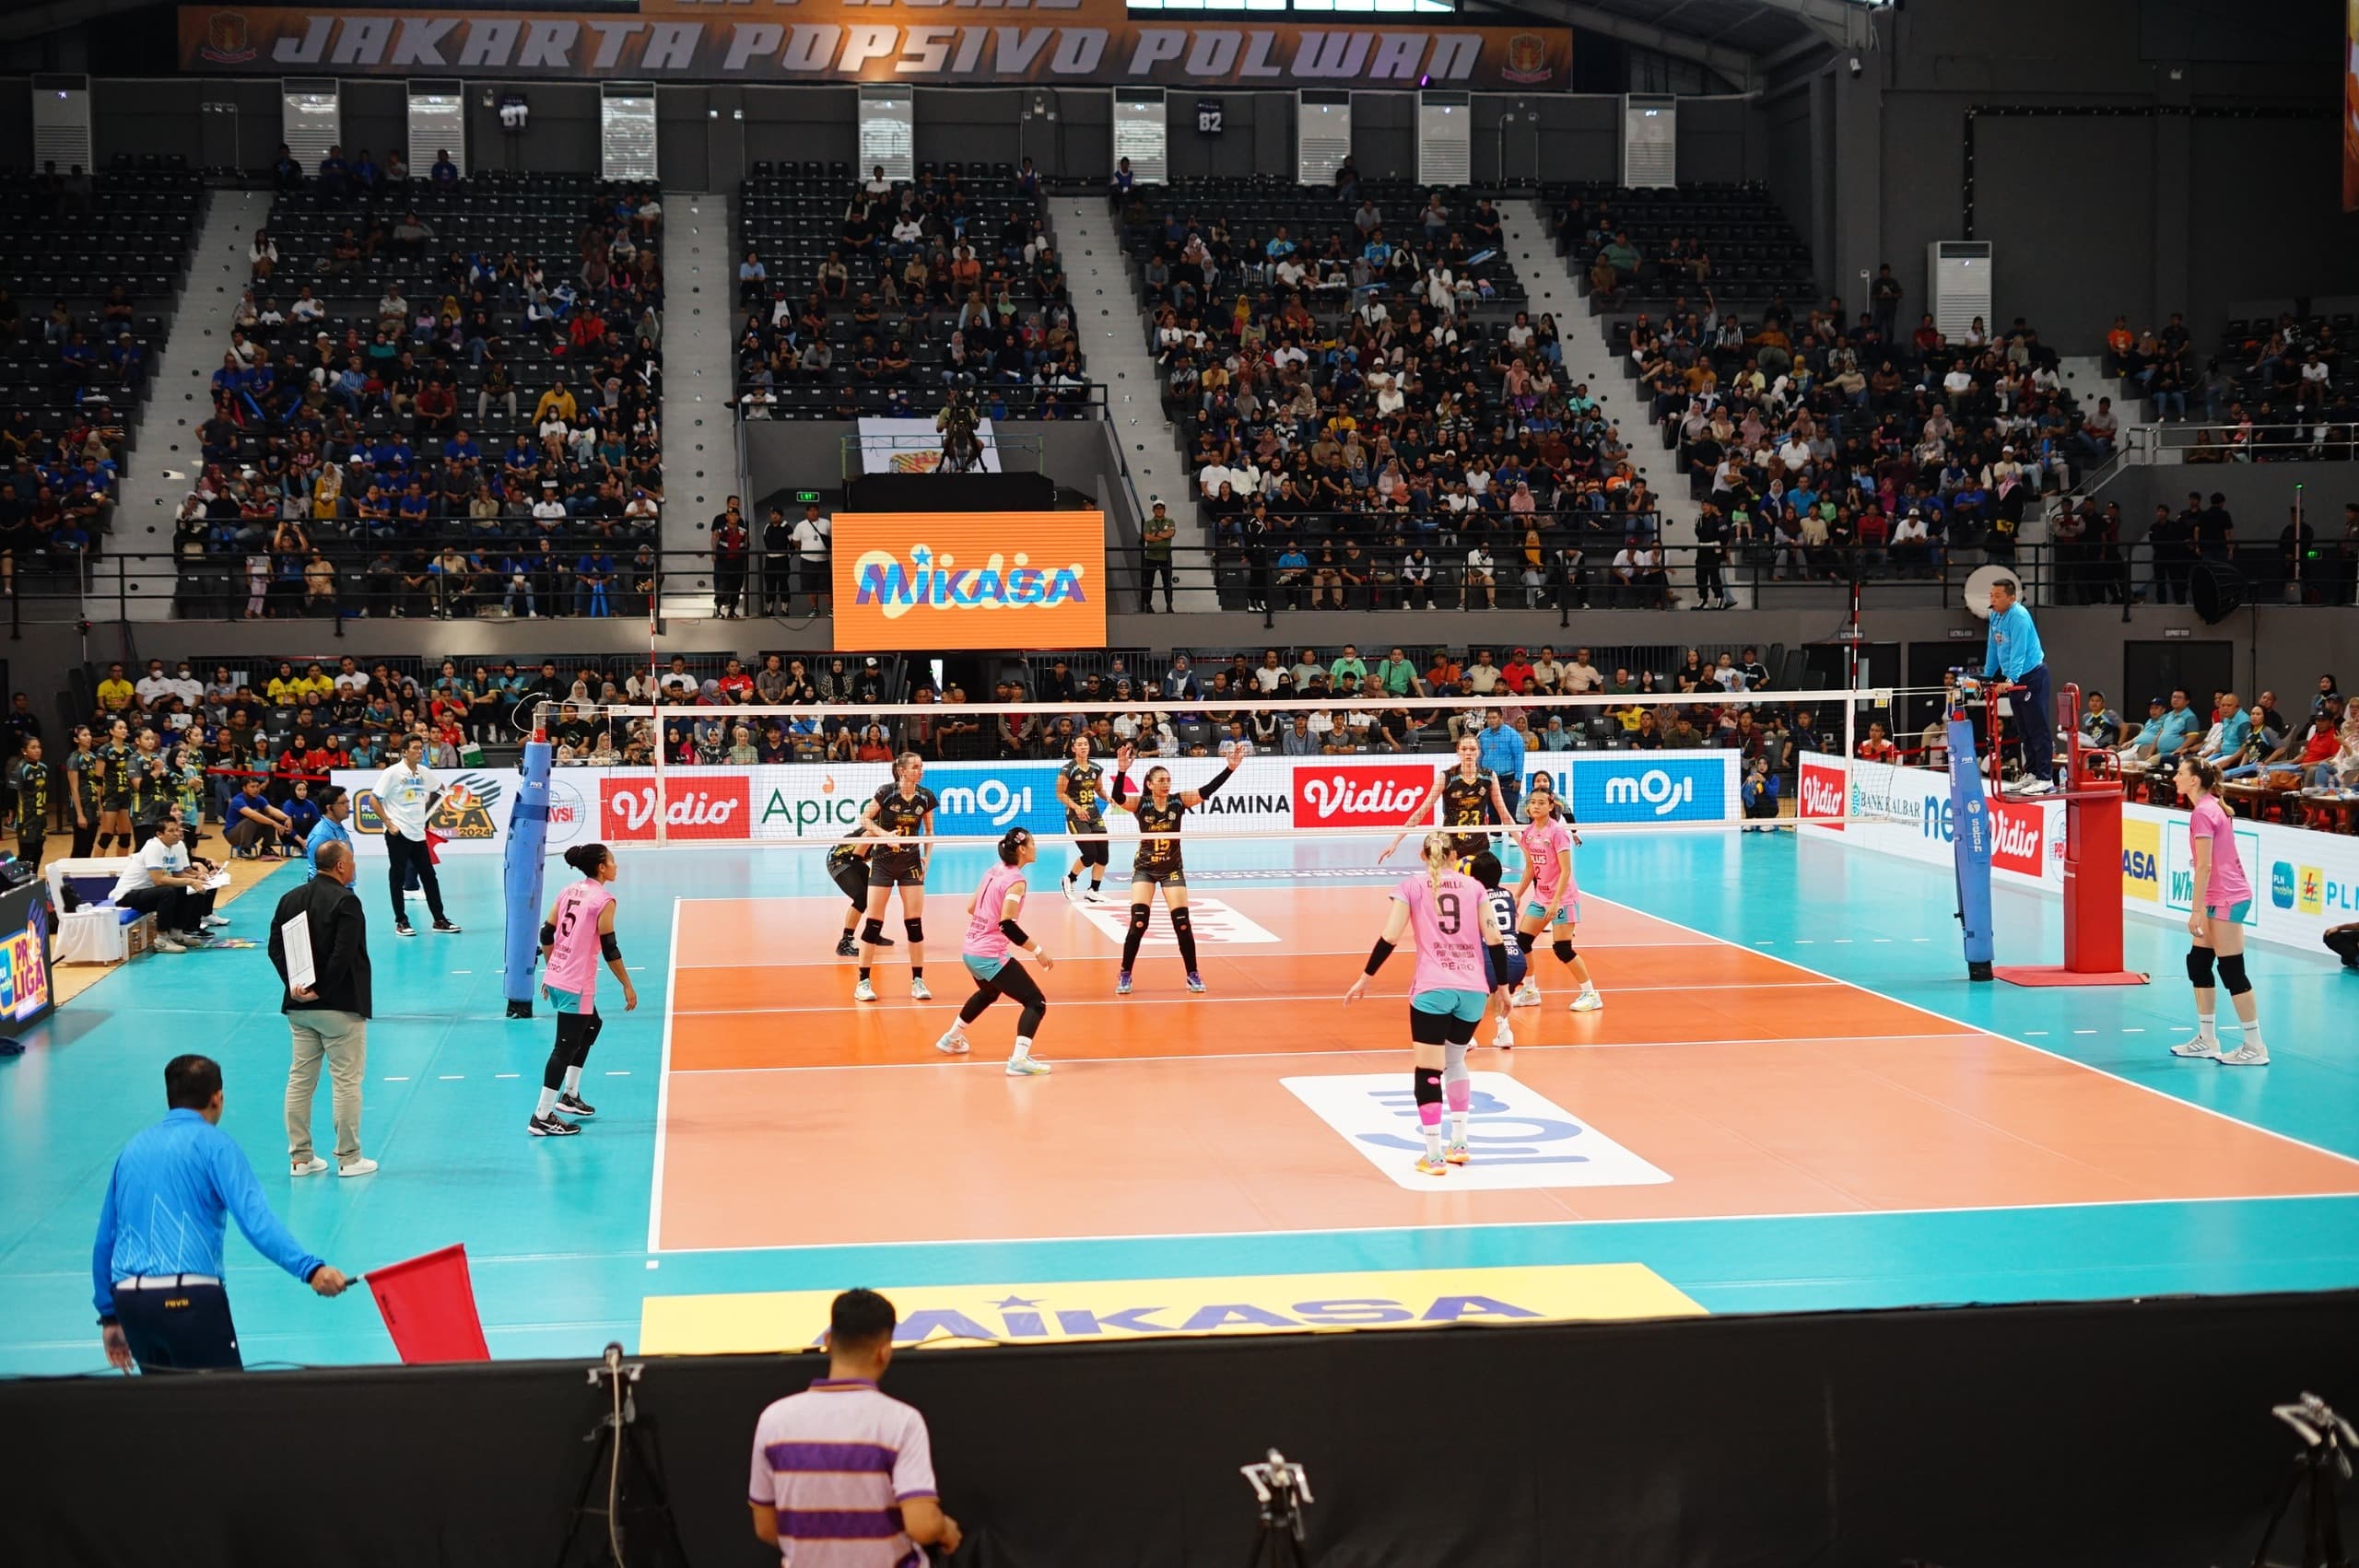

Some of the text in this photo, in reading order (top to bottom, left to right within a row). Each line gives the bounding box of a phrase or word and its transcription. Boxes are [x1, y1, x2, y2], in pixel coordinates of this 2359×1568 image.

[273, 16, 1484, 80] JAKARTA POPSIVO POLWAN
[1199, 111, 1222, 132] B2
[612, 788, 738, 831] Vdio
[1185, 794, 1290, 814] TAMINA
[1304, 776, 1424, 818] Vidio
[1803, 775, 1842, 815] Vidio
[1861, 792, 1920, 818] BANK KALBAR
[548, 807, 573, 822] VSI
[762, 788, 875, 837] Apic
[1458, 810, 1480, 826] 23
[1989, 809, 2038, 859] Vidio
[2122, 849, 2157, 882] ASA
[2273, 874, 2285, 885] PLN
[1426, 880, 1464, 889] CMILLA
[561, 899, 581, 938] 5
[1438, 894, 1461, 935] 9
[1490, 898, 1511, 930] 6
[1557, 908, 1564, 919] 2
[13, 960, 45, 1004] LIGA
